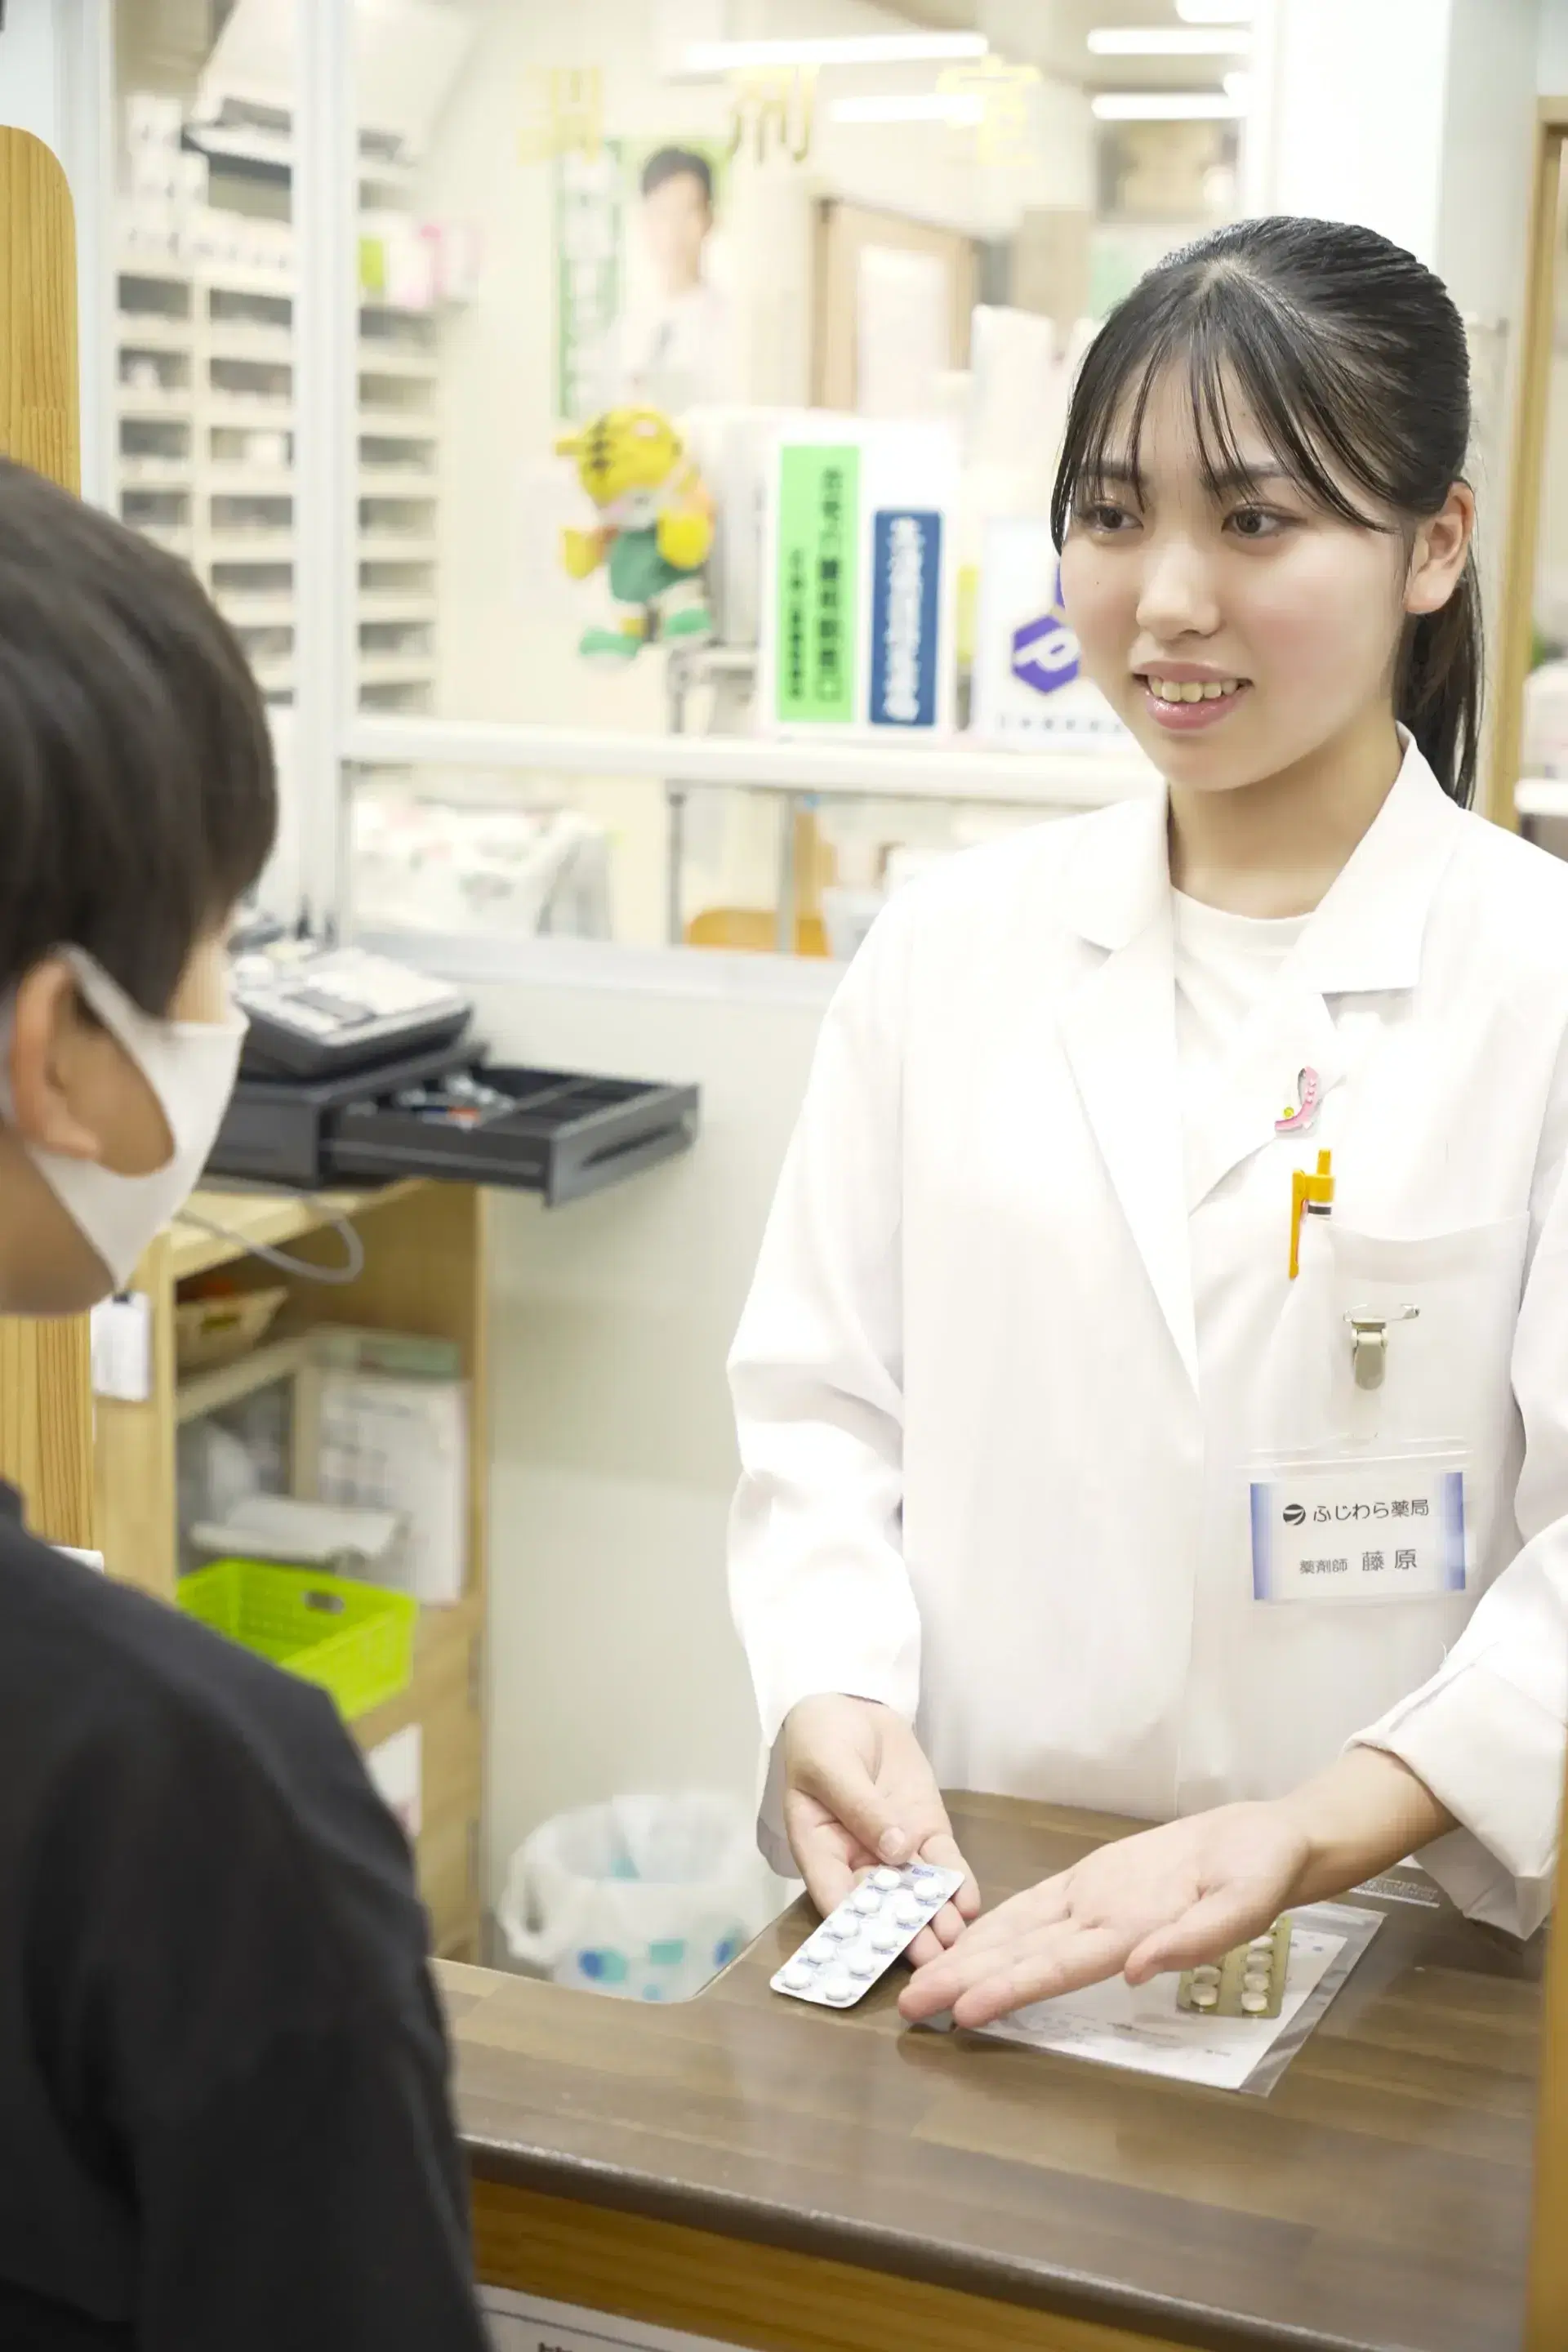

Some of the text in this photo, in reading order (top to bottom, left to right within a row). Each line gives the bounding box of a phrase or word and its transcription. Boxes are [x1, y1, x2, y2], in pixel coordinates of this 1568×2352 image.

[1312, 1499, 1429, 1522] ふじわら薬局
[1298, 1548, 1418, 1575] 薬剤師 藤原
